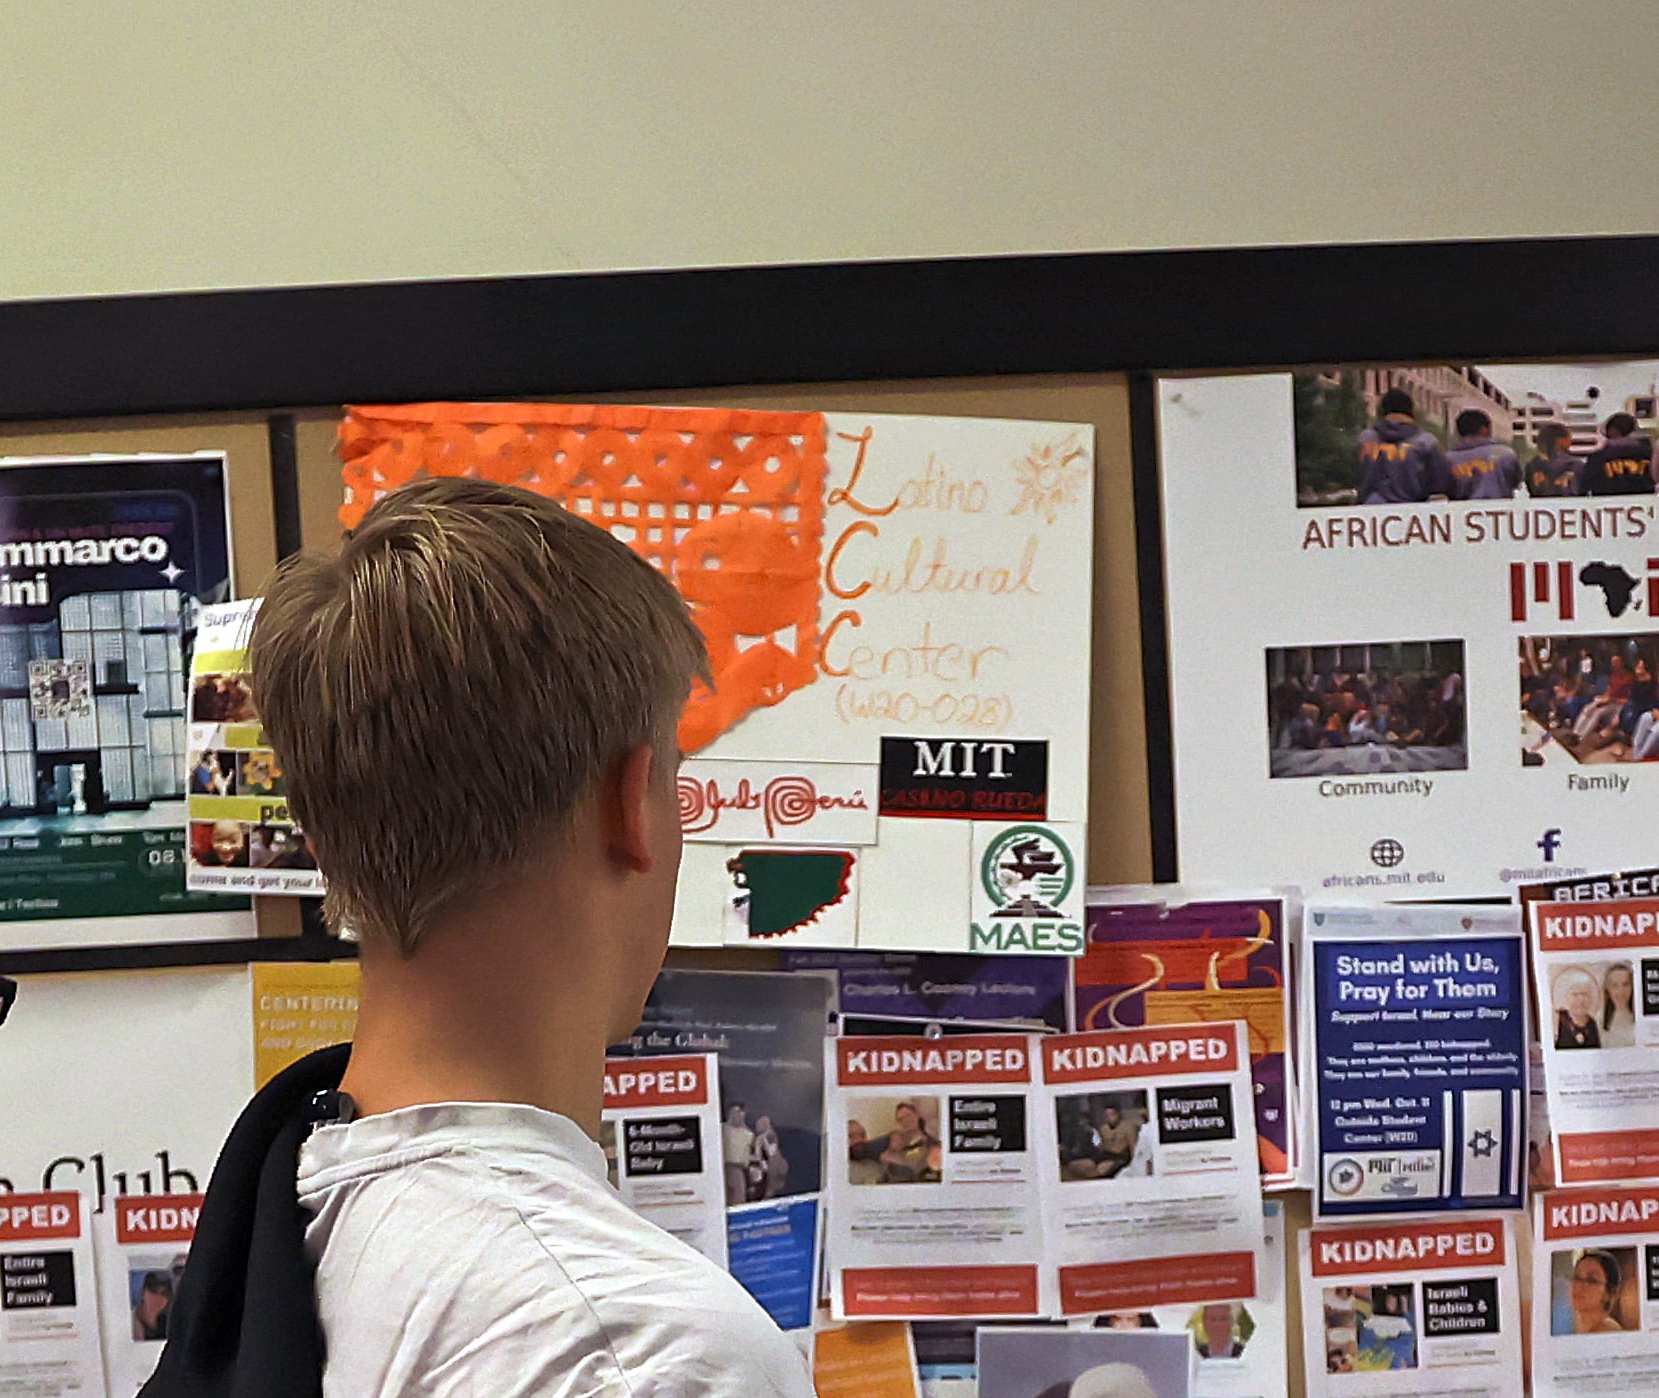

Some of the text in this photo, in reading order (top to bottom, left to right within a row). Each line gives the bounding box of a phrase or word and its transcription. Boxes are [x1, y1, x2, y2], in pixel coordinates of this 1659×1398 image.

[1303, 511, 1453, 550] AFRICAN
[1465, 505, 1655, 544] STUDENTS'
[825, 522, 1040, 599] Cultural
[818, 611, 1008, 681] Center
[913, 741, 1015, 778] MIT
[1318, 777, 1434, 799] Community
[1567, 772, 1629, 795] Family
[970, 923, 1082, 952] MAES
[1336, 952, 1499, 975] Stand with Us,
[1340, 977, 1496, 1006] Pray for Them
[846, 1049, 1025, 1074] KIDNAPPED
[1051, 1038, 1228, 1072] KIDNAPPED
[1320, 1232, 1496, 1265] KIDNAPPED
[1426, 1287, 1469, 1300] Israeli
[1428, 1314, 1487, 1330] Children
